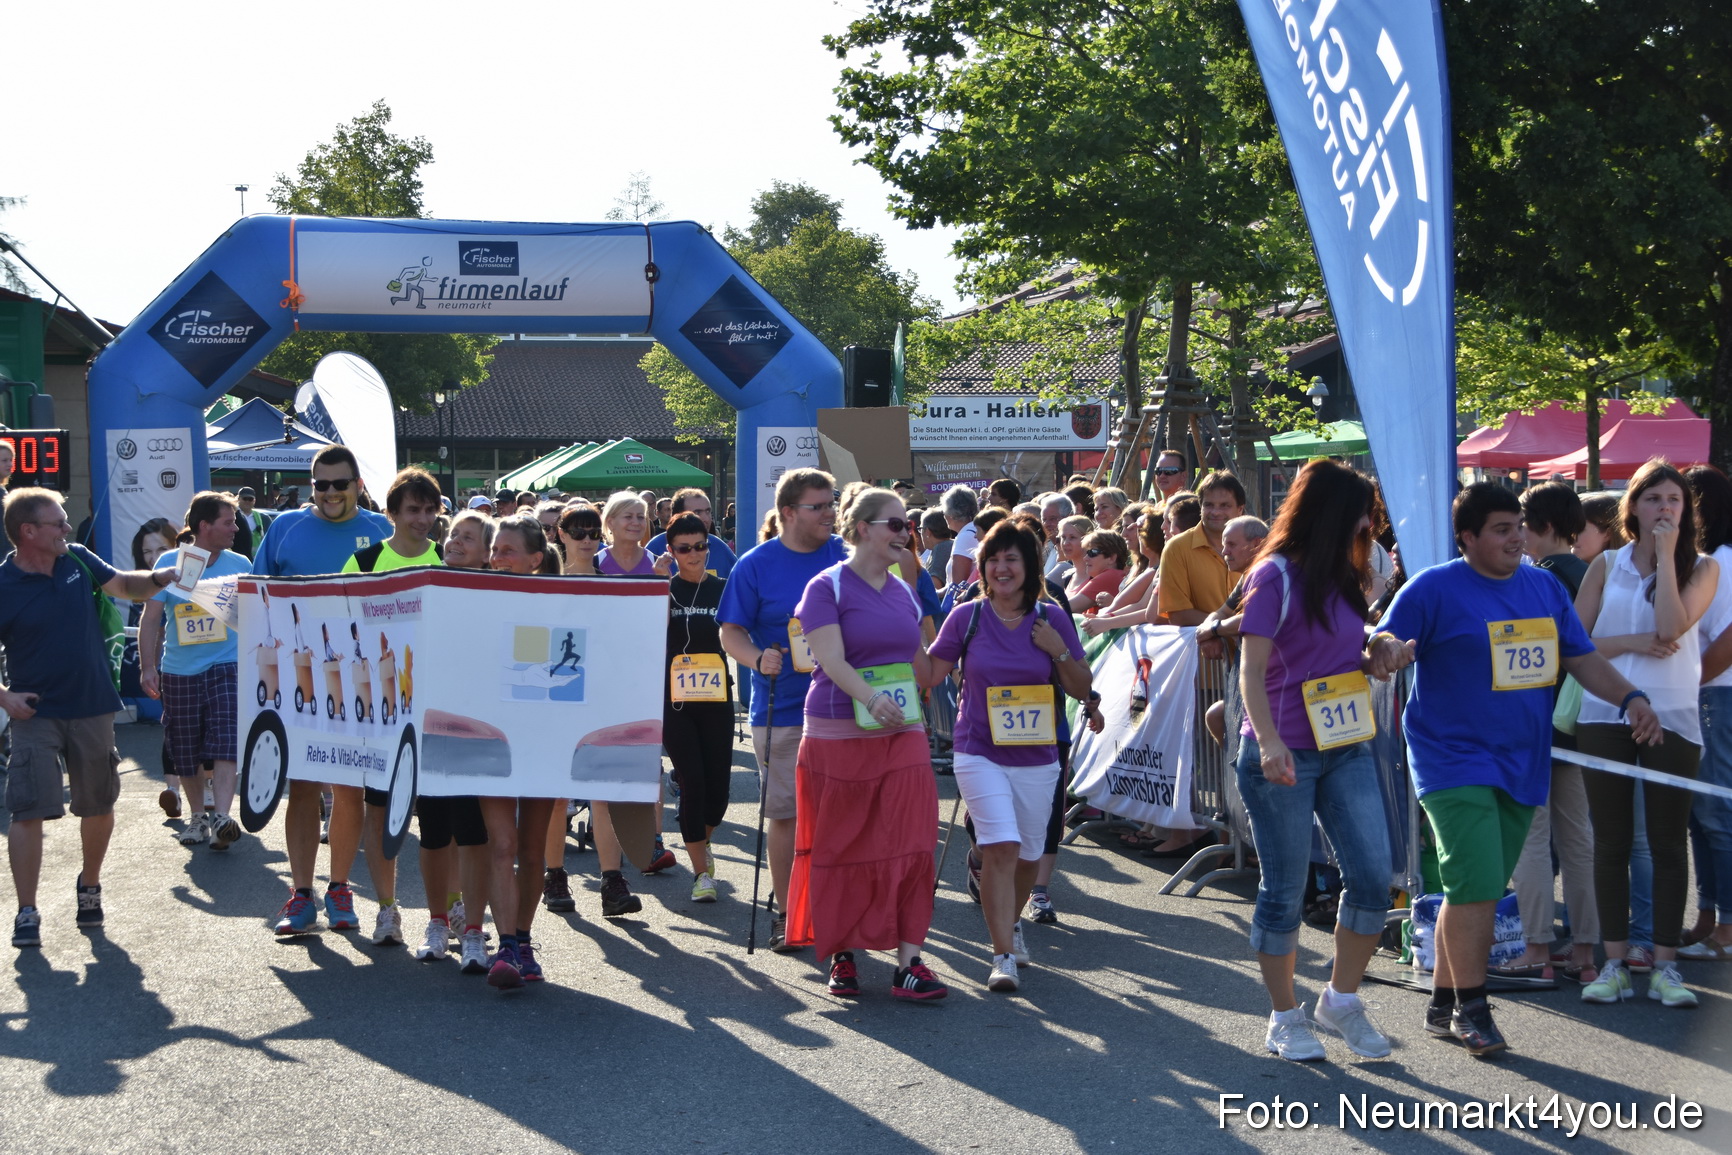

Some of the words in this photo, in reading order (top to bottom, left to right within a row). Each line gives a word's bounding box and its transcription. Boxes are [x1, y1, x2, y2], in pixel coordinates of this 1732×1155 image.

[472, 254, 515, 263] Fischer
[439, 276, 569, 300] firmenlauf
[438, 301, 492, 309] neumarkt
[181, 322, 253, 336] Fischer
[725, 321, 742, 331] das
[924, 461, 977, 472] Willkommen
[947, 470, 981, 479] meinem
[162, 474, 175, 485] FIAT
[396, 596, 422, 615] Neumarkt
[186, 617, 215, 633] 817
[1505, 646, 1545, 670] 783
[677, 672, 721, 688] 1174
[1002, 710, 1040, 729] 317
[1321, 700, 1358, 729] 311
[306, 745, 329, 763] Reha-
[331, 747, 336, 764] &
